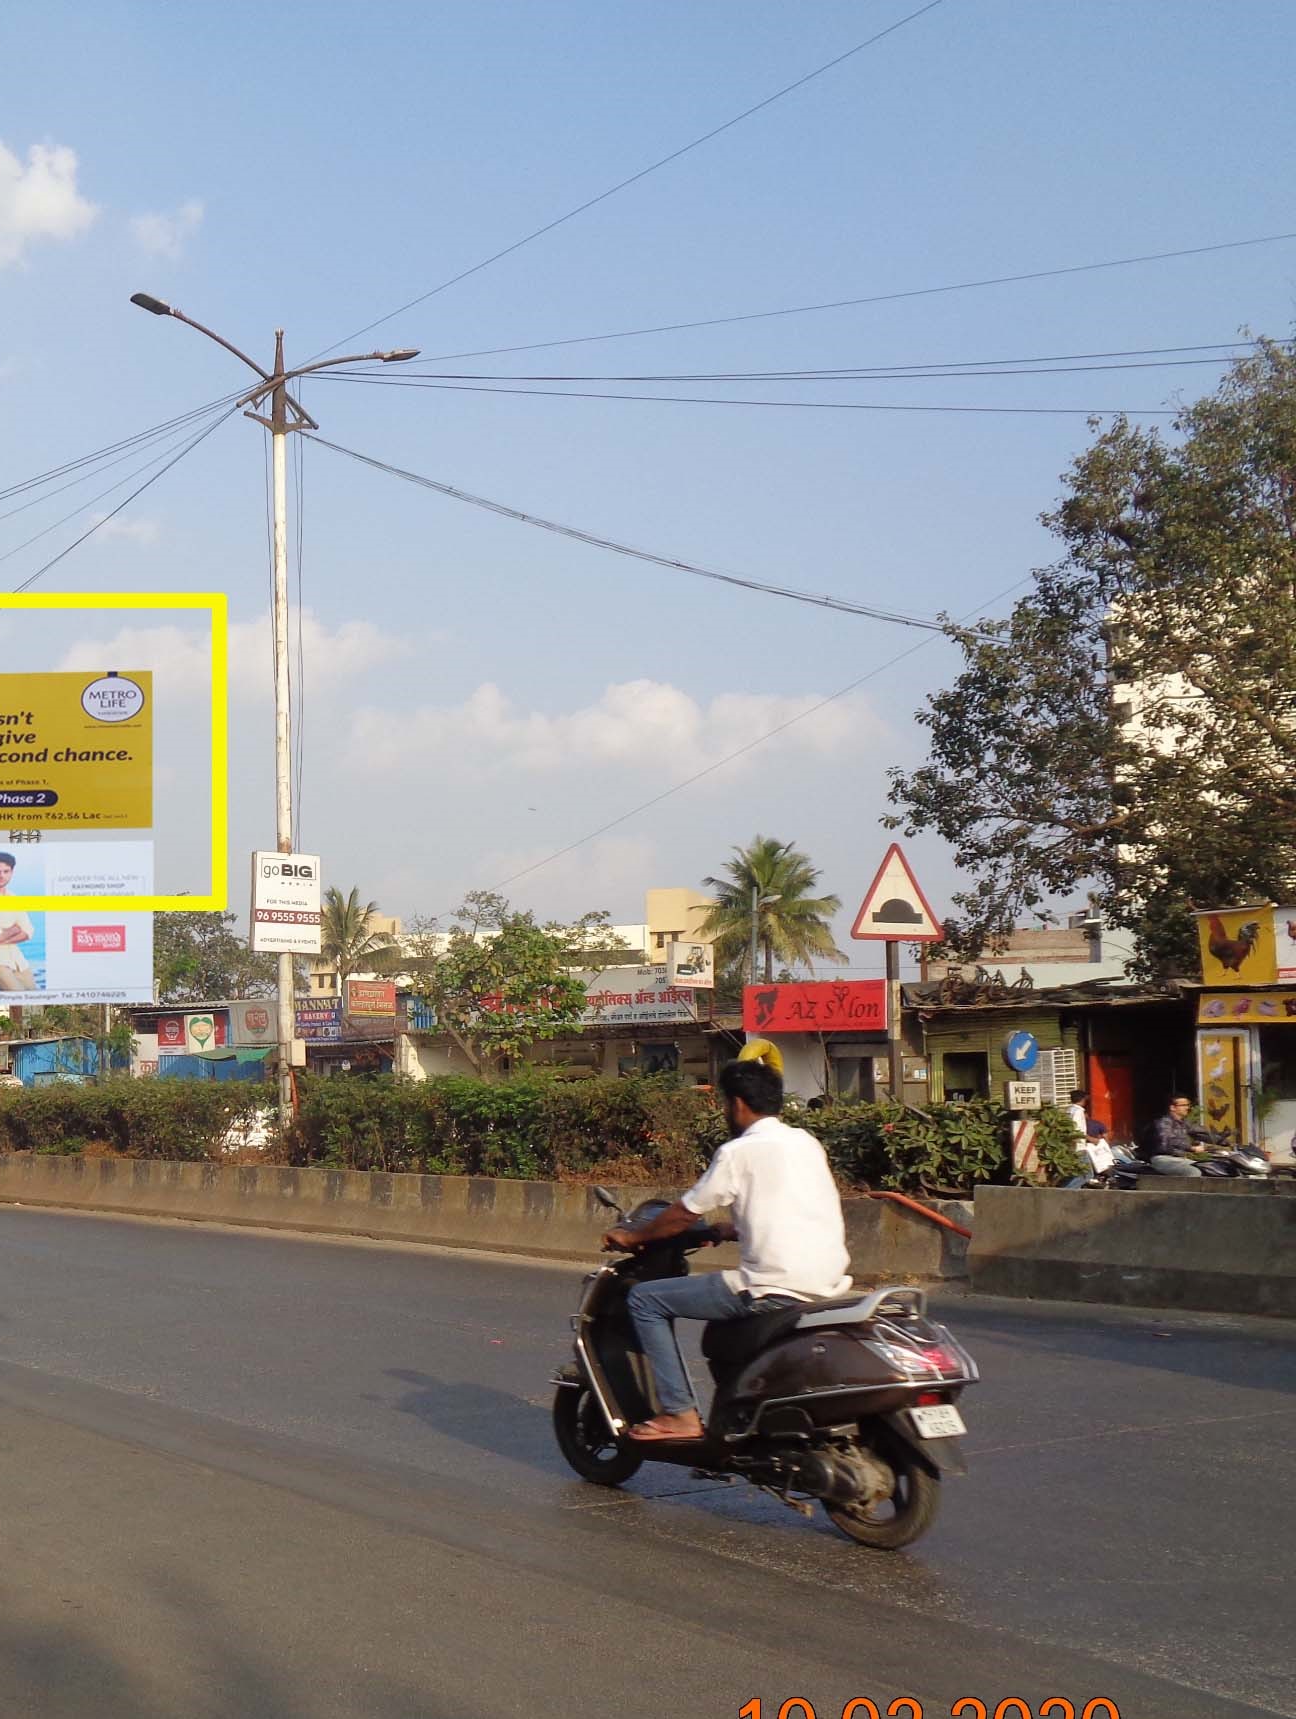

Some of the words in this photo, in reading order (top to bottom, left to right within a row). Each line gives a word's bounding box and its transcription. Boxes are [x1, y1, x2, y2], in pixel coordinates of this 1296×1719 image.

[88, 690, 137, 700] METRO
[100, 699, 126, 708] LIFE
[53, 747, 133, 763] chance.
[35, 793, 46, 804] 2
[17, 812, 43, 821] from
[82, 812, 101, 820] Lac
[256, 911, 270, 920] 96
[271, 911, 295, 922] 9555
[296, 913, 321, 923] 9555
[1014, 1086, 1037, 1094] KEEP
[1015, 1096, 1036, 1105] LEFT
